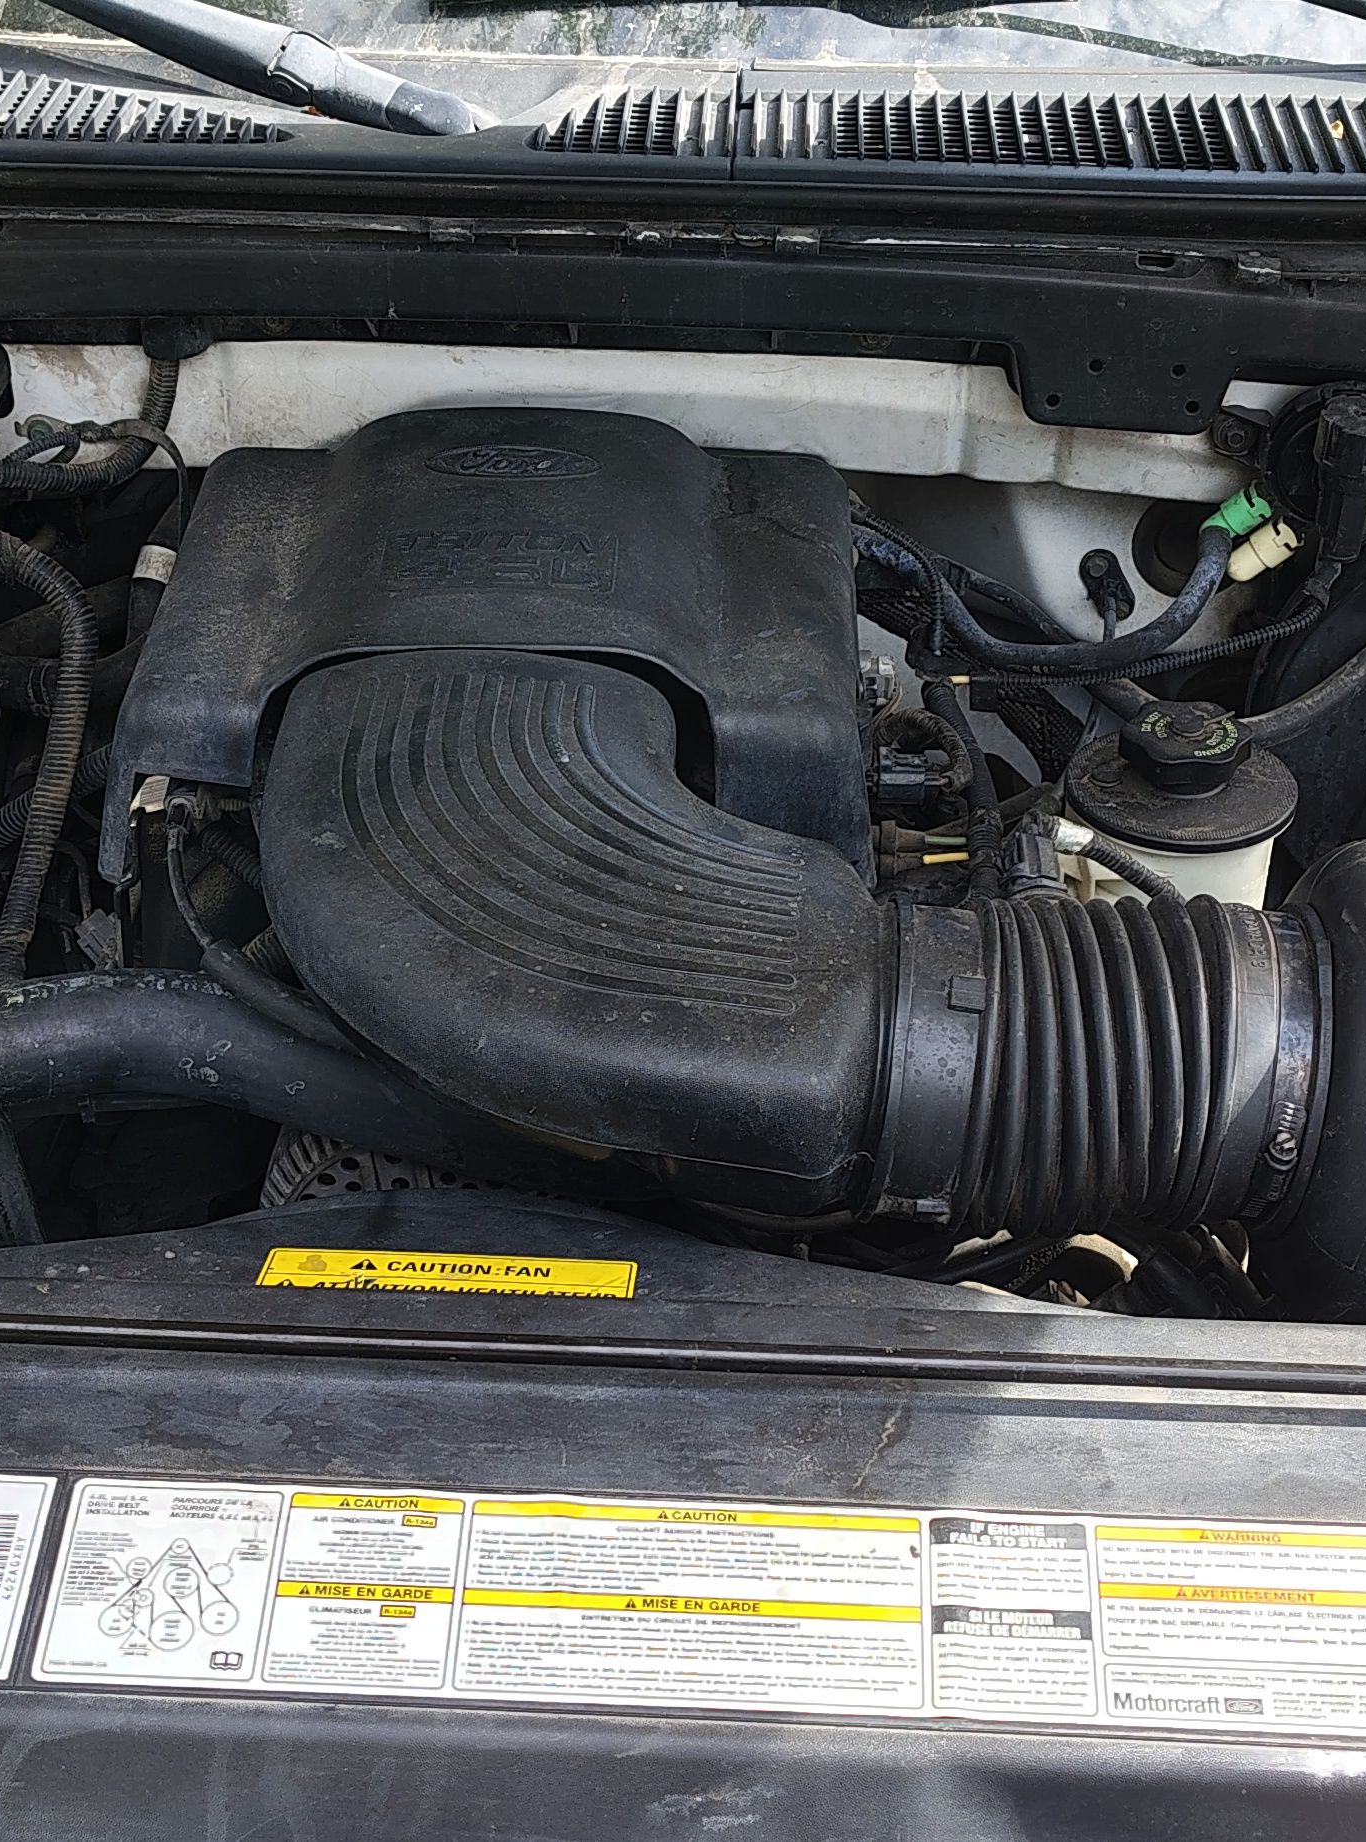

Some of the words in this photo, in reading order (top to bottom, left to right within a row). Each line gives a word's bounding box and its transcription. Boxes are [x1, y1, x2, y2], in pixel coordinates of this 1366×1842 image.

[459, 447, 574, 474] Ford
[173, 1496, 223, 1505] PARCOURS
[353, 1498, 419, 1509] CAUTION
[170, 1504, 220, 1512] COURROIE
[170, 1511, 215, 1520] MOTEURS
[672, 1511, 738, 1522] CAUTION
[970, 1521, 985, 1533] IF
[987, 1523, 1045, 1537] ENGINE
[949, 1532, 992, 1546] FAILS
[994, 1536, 1017, 1547] TO
[1018, 1537, 1067, 1549] START
[1212, 1532, 1282, 1543] WARNING
[315, 1585, 351, 1597] MISE
[356, 1587, 375, 1598] EN
[381, 1588, 433, 1600] GARDE
[1191, 1588, 1316, 1603] AVERTISSEMENT
[642, 1599, 679, 1610] MISE
[684, 1600, 703, 1611] EN
[709, 1601, 761, 1613] GARDE
[1001, 1611, 1054, 1625] MOTEUR
[1114, 1691, 1222, 1715] Motorcraft
